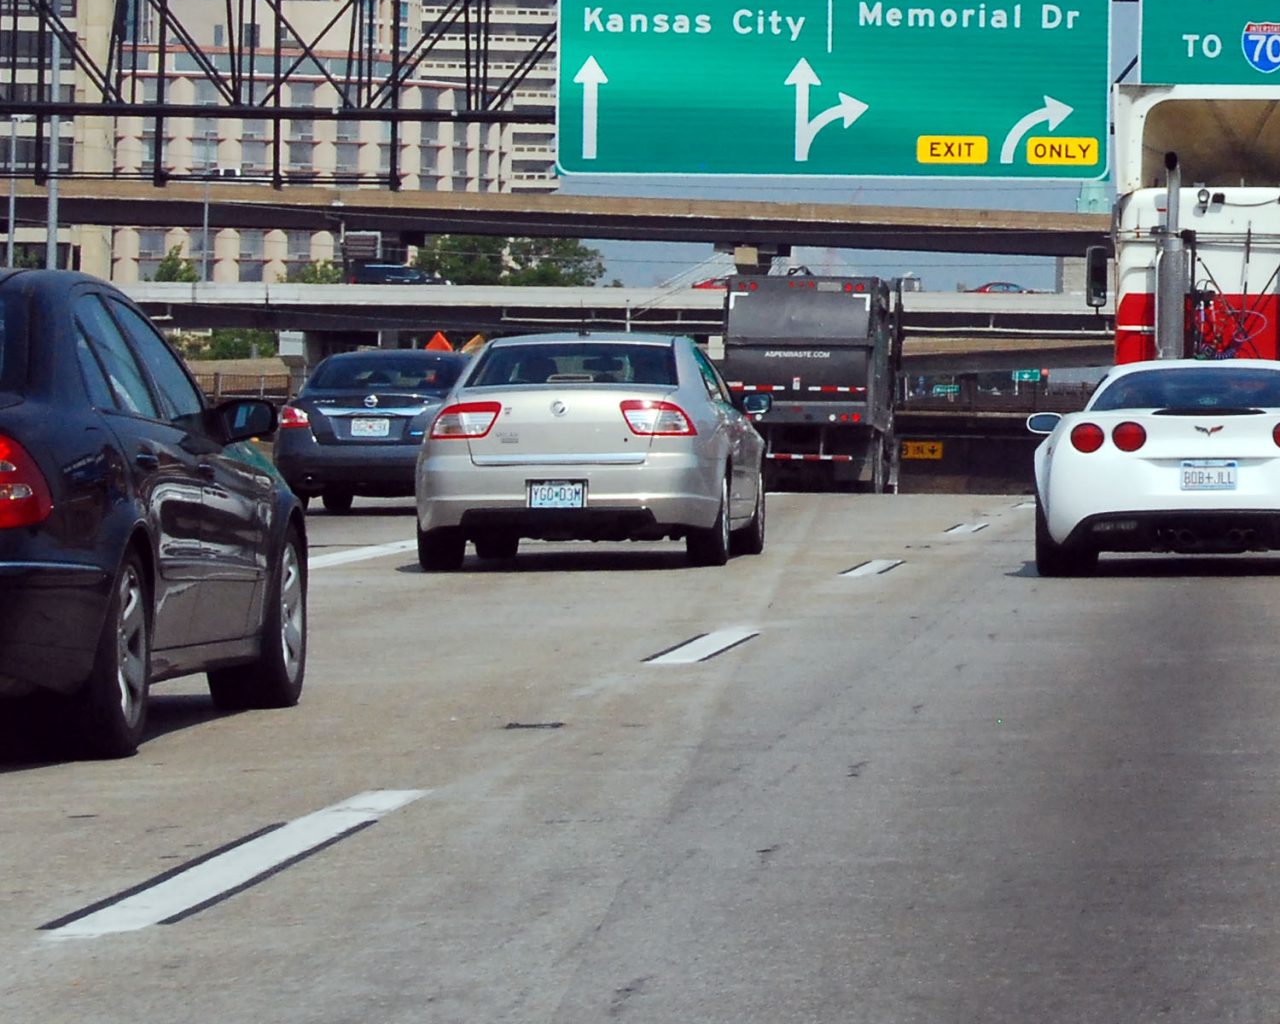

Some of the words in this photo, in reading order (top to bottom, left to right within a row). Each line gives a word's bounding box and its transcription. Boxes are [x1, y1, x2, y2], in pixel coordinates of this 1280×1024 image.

[583, 7, 712, 34] Kansas
[733, 9, 805, 41] City
[858, 1, 1021, 29] Memorial
[1041, 5, 1080, 29] Dr
[1182, 35, 1222, 59] TO
[930, 142, 975, 157] EXIT
[1034, 144, 1091, 159] ONLY
[765, 350, 831, 358] ASPENWASTE.COM
